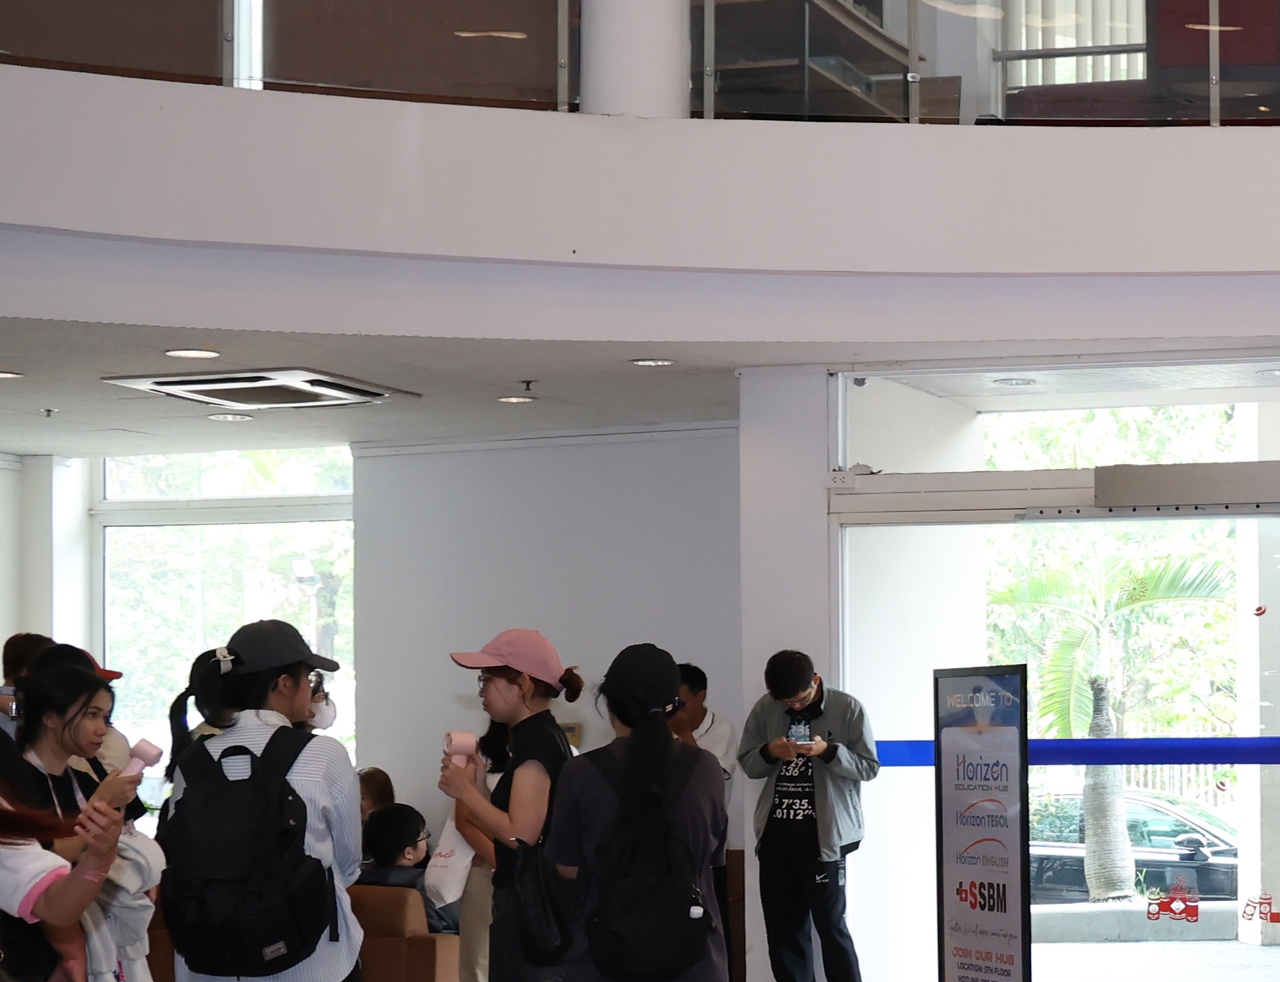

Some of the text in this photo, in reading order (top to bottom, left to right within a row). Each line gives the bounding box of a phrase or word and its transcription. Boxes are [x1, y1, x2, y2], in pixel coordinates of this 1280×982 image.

[946, 691, 1013, 708] WELCOME TO
[954, 783, 1009, 792] EDUCATION HUB
[956, 811, 1009, 828] Horizon TESOL
[956, 852, 1009, 868] Horizon ENGLISH
[969, 880, 1007, 913] SSBM
[951, 946, 1015, 966] JOIN OUR HUB
[994, 967, 1011, 977] FLOOR
